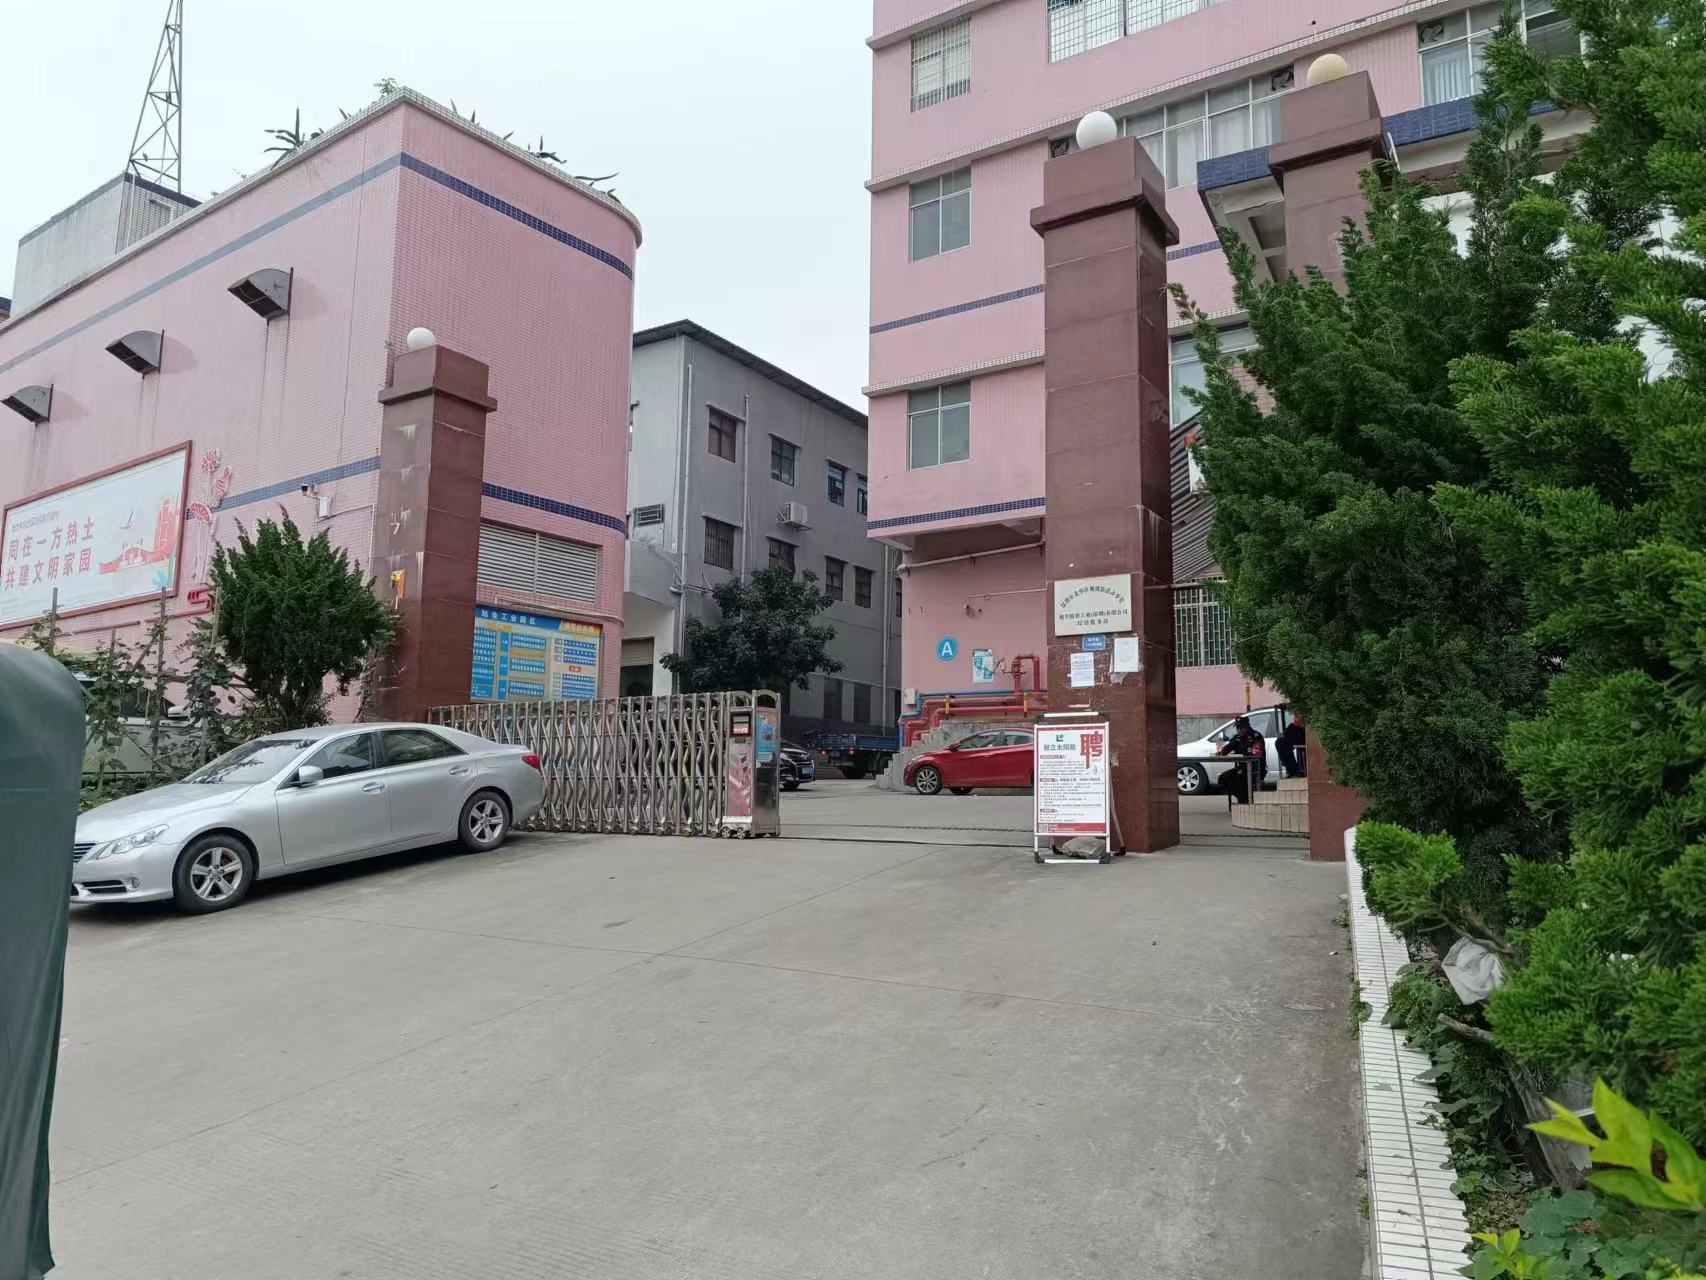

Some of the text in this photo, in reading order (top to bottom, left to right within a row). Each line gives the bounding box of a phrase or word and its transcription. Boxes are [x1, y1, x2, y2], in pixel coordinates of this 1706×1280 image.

[8, 516, 95, 561] 同在一方热土
[5, 548, 92, 591] 共建文明家园
[941, 641, 953, 657] A
[1080, 731, 1104, 769] 聘
